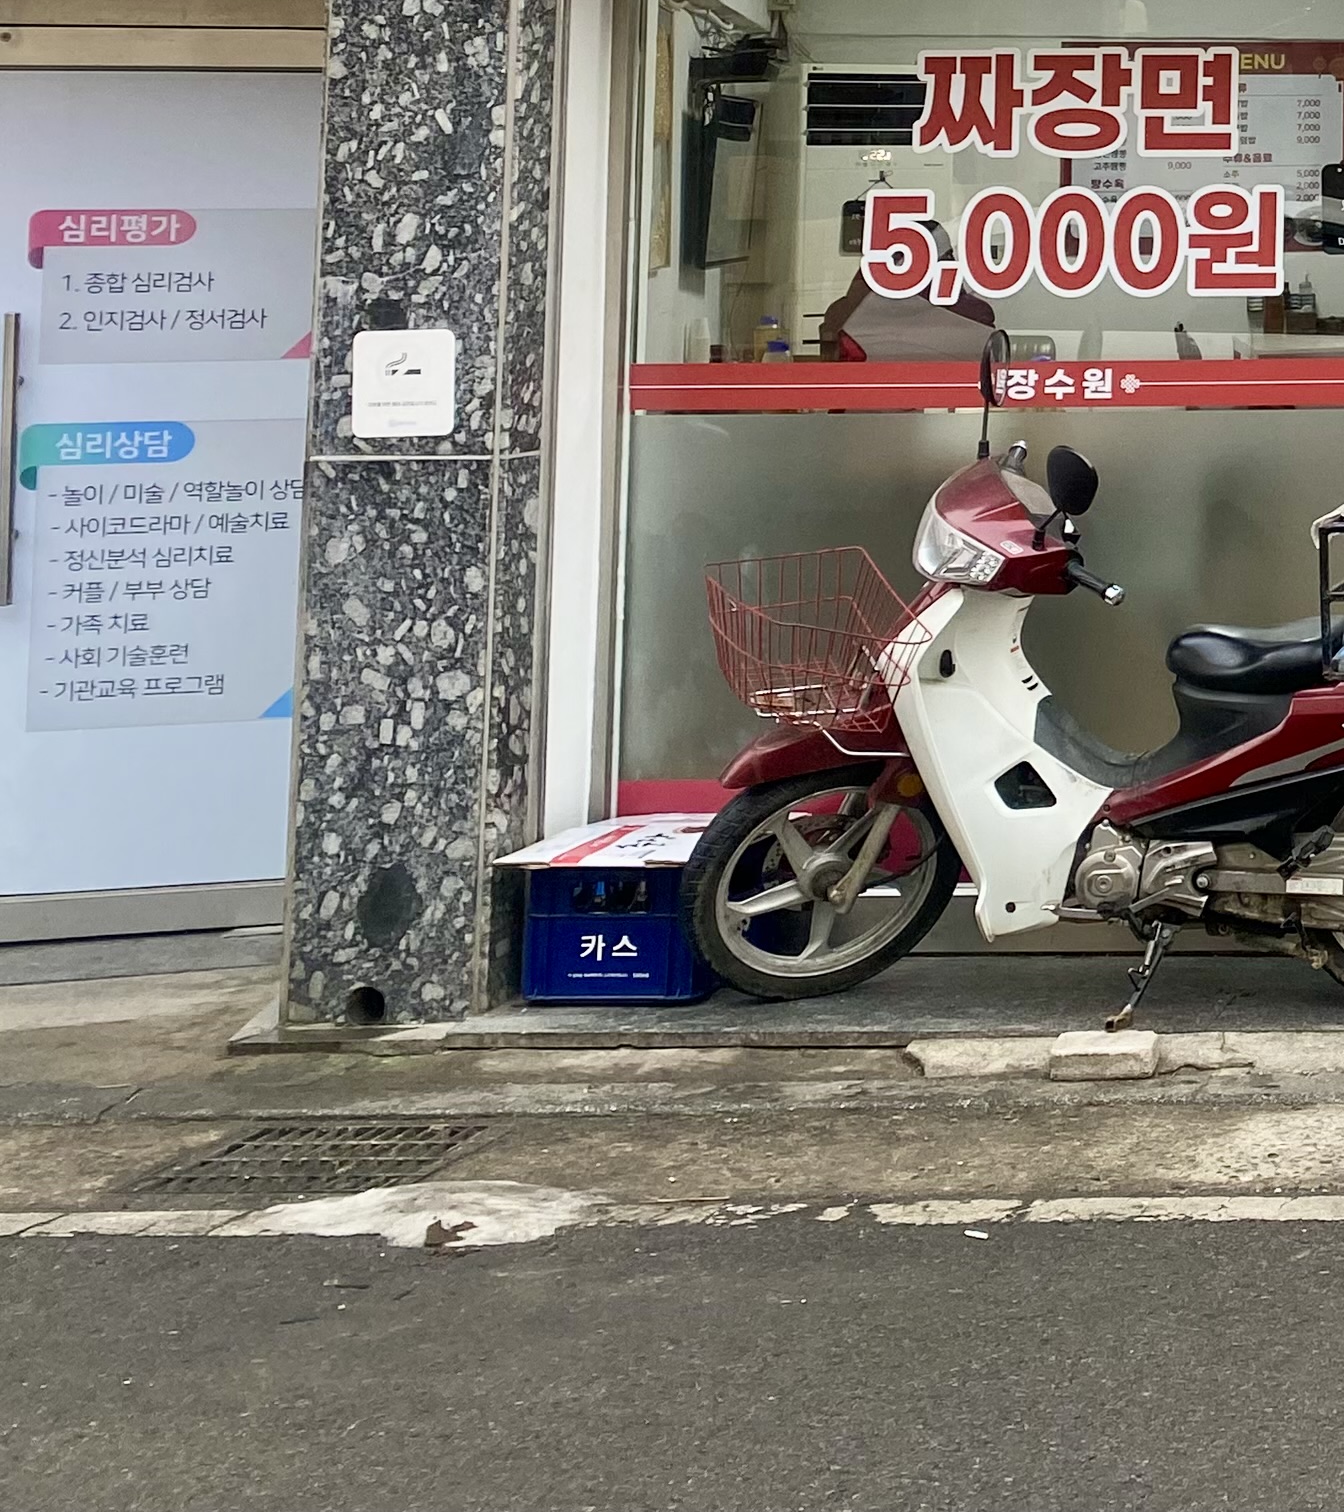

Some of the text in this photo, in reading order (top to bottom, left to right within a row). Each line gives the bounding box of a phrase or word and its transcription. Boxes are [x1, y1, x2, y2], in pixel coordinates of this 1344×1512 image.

[1240, 54, 1286, 70] ENU
[916, 49, 1236, 155] 짜장면
[1297, 100, 1320, 108] 7,000
[1297, 112, 1320, 120] 7,000
[1297, 124, 1320, 132] 7,000
[1168, 162, 1192, 170] 9,000
[58, 214, 181, 244] 심리평가
[866, 189, 1281, 302] 5,000원
[61, 271, 215, 294] 1. 종합 심리검사
[58, 308, 268, 332] 2. 인지검사 정서검사
[1006, 368, 1113, 400] 장수원
[55, 430, 172, 460] 심리상담
[62, 484, 104, 506] 놀이
[124, 484, 164, 504] 미술
[184, 480, 264, 502] 역할놀이
[64, 511, 290, 538] 사이코드라마 예술치료
[64, 544, 235, 572] 정신분석 심리치료
[63, 577, 212, 604] 커플 부부 상담
[60, 612, 150, 636] 가족 치료
[58, 643, 190, 669] 사회 기술훈련
[54, 674, 226, 703] 기관교육 프로그램
[580, 934, 638, 961] 카스
